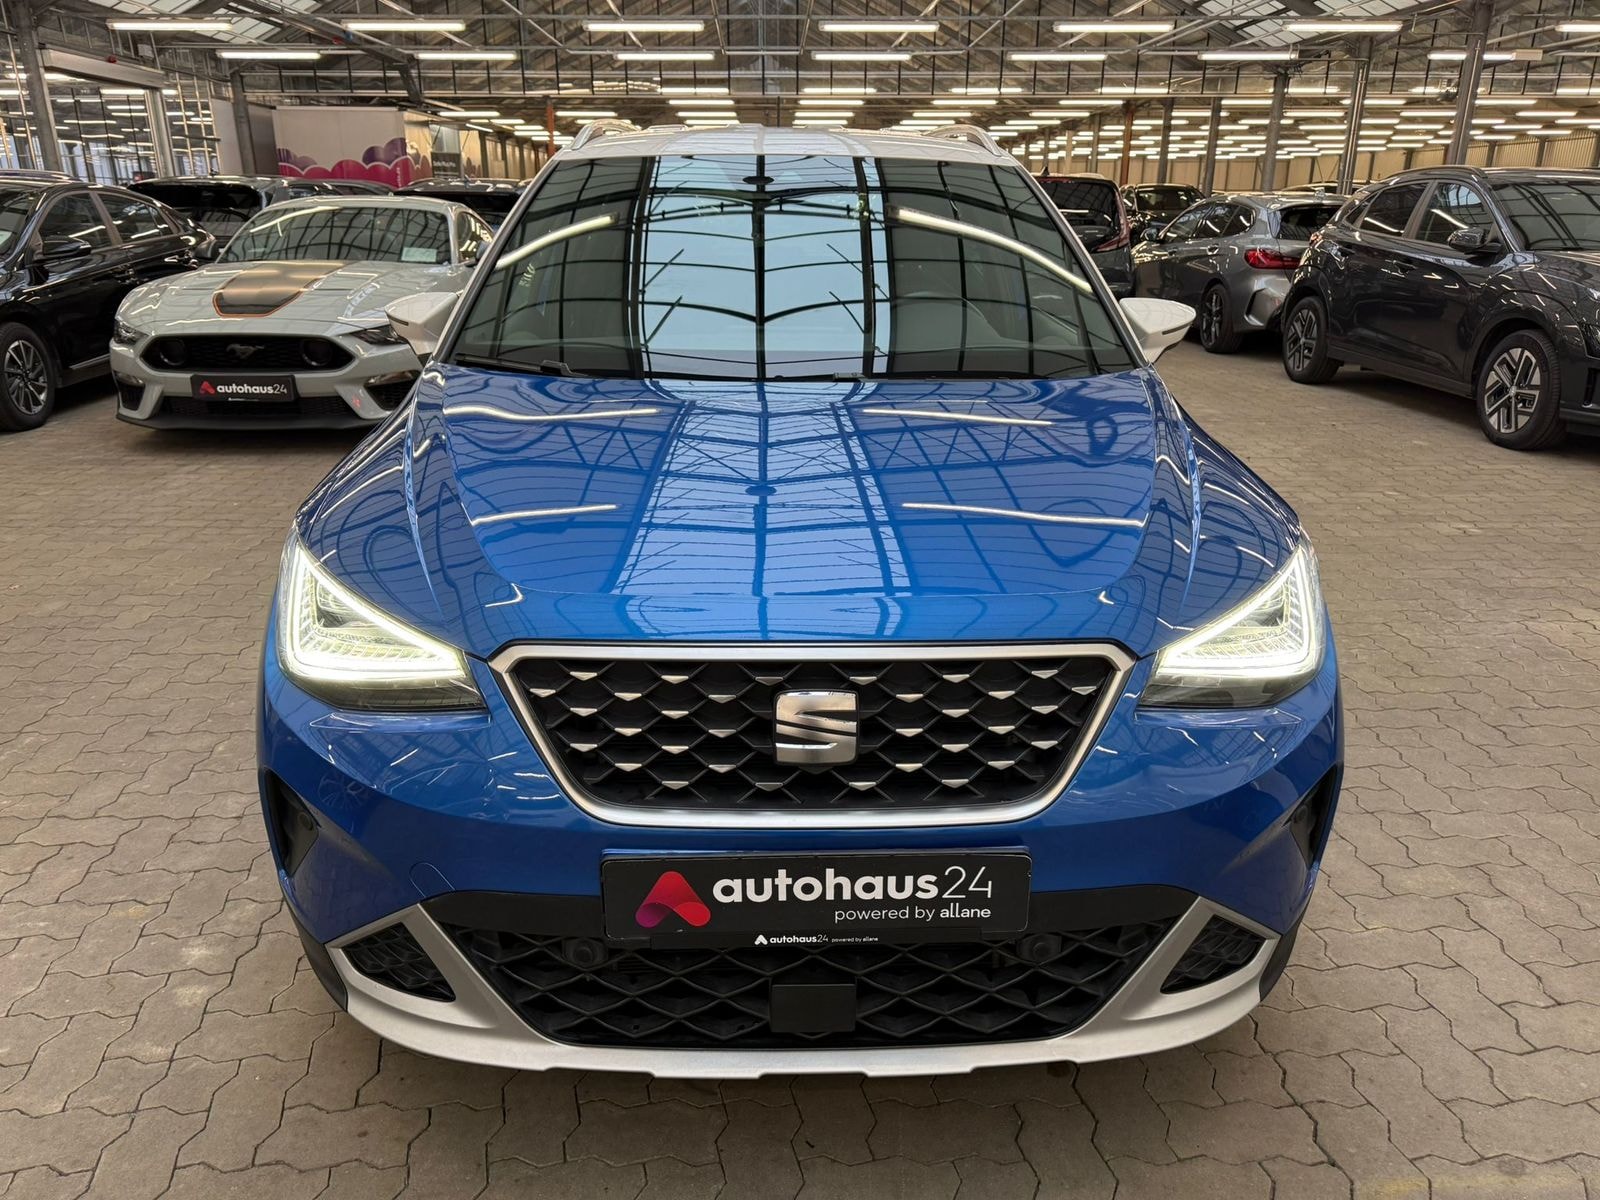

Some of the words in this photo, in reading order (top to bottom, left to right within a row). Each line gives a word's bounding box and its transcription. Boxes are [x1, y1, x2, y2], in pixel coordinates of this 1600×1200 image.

[216, 383, 288, 394] autohaus24
[712, 865, 993, 903] autohaus24
[834, 905, 910, 924] powered
[914, 905, 936, 922] by
[939, 902, 992, 919] allane
[769, 934, 829, 944] autohaus24
